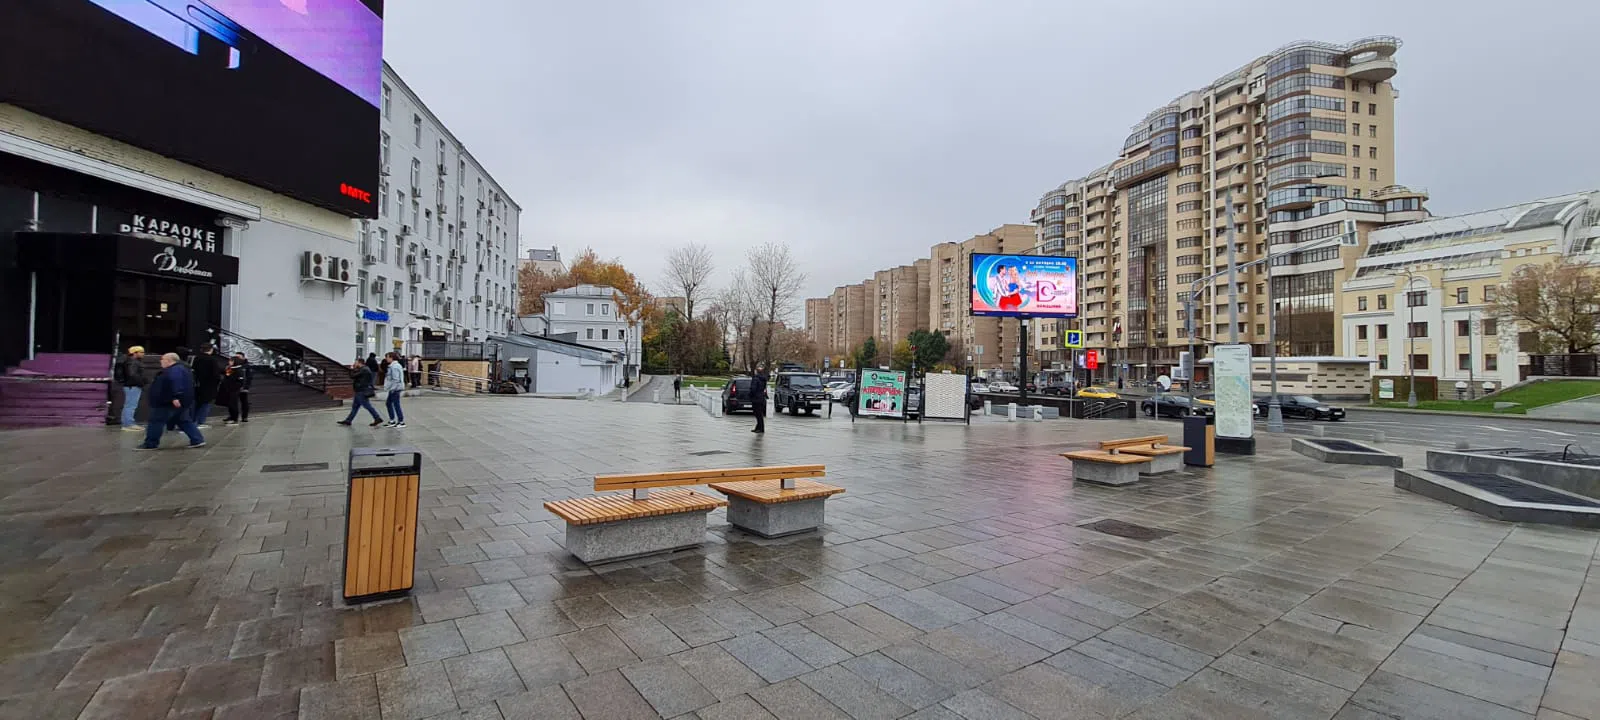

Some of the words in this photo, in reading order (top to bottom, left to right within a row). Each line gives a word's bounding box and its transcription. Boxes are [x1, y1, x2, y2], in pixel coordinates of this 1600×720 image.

[348, 186, 371, 204] МТС
[119, 223, 216, 253] РЕРАН
[133, 214, 216, 243] КАРАОКЕ
